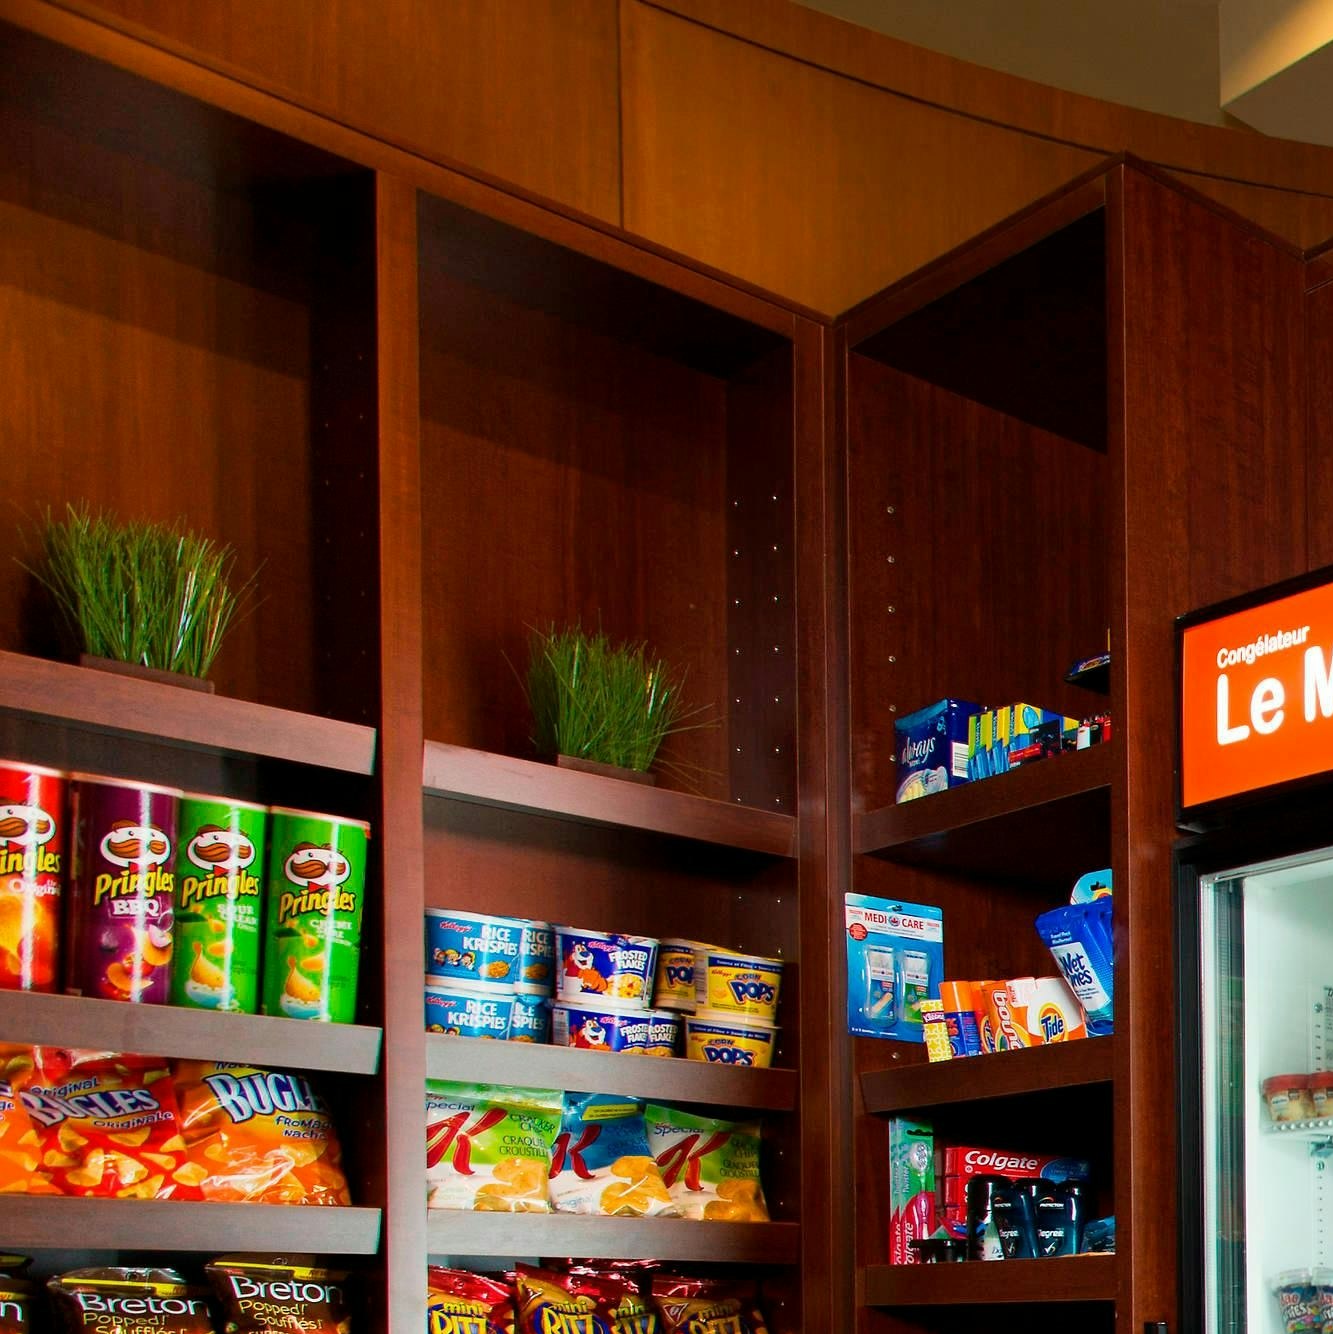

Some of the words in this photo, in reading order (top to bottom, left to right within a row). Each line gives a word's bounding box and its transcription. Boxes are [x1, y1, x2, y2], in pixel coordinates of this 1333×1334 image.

[1217, 625, 1310, 668] Congélateur
[1217, 674, 1285, 746] Le
[94, 867, 174, 906] Pringles
[181, 869, 260, 908] Pringles
[280, 888, 356, 925] Pringles
[864, 912, 887, 924] MEDI
[902, 917, 924, 930] CARE
[480, 924, 511, 942] RICE
[463, 936, 519, 956] KRISPIES
[607, 949, 649, 964] FROSTED
[731, 981, 775, 1002] POPS
[466, 1000, 498, 1015] RICE
[448, 1011, 507, 1031] KRISPIES
[1040, 1015, 1064, 1042] Tide
[704, 1044, 754, 1066] POPS
[21, 1088, 161, 1128] BUGLES
[965, 1150, 1039, 1171] Colgate
[229, 1275, 344, 1304] Breton
[77, 1292, 211, 1315] Breton
[239, 1299, 307, 1315] Popped!
[83, 1312, 166, 1327] Popped!
